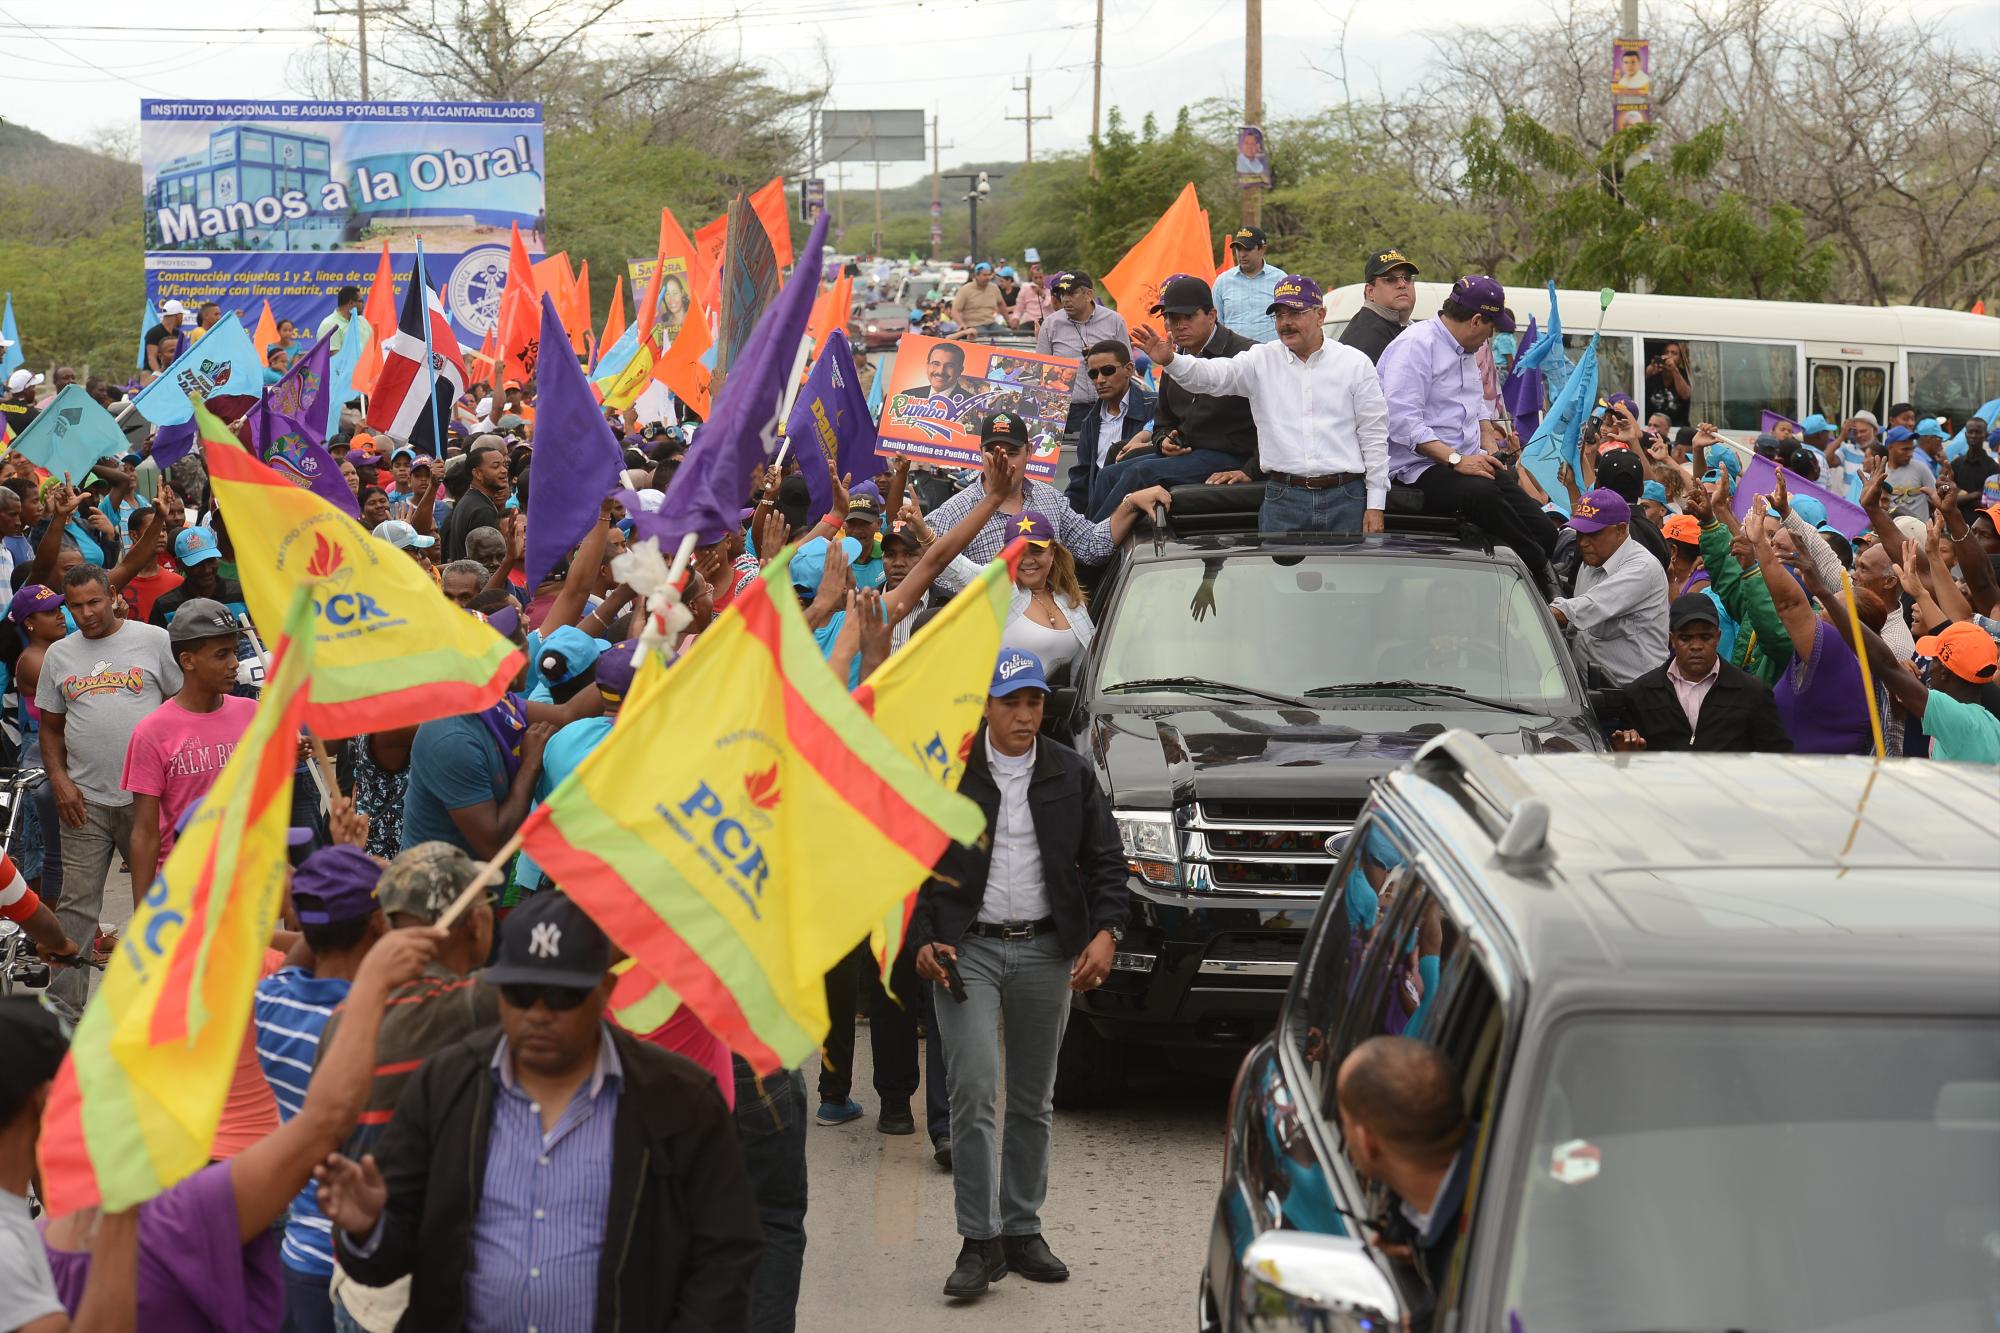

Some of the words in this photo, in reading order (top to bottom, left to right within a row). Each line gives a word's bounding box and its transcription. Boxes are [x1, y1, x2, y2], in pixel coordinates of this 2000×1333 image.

[150, 103, 214, 117] INSTITUTO
[216, 103, 280, 117] NACIONAL
[281, 105, 299, 117] DE
[300, 104, 344, 117] AGUAS
[346, 105, 409, 118] POTABLES
[411, 106, 419, 117] Y
[421, 105, 536, 120] ALCANTARILLADOS
[156, 185, 309, 246] Manos
[318, 180, 350, 213] a
[355, 165, 400, 206] la
[407, 133, 535, 194] Obra!
[158, 270, 231, 282] Construcción
[283, 271, 290, 282] 1
[293, 273, 300, 284] y
[302, 271, 312, 283] 2,
[316, 270, 344, 281] línea
[345, 270, 361, 281] de
[158, 285, 227, 298] H/Empalme
[252, 284, 280, 295] línea
[283, 284, 323, 297] matriz,
[888, 393, 947, 419] Rumbo
[882, 439, 906, 451] Danilo
[906, 443, 934, 456] Medina
[934, 448, 944, 456] es
[168, 746, 213, 778] PALM
[677, 778, 769, 900] PCR
